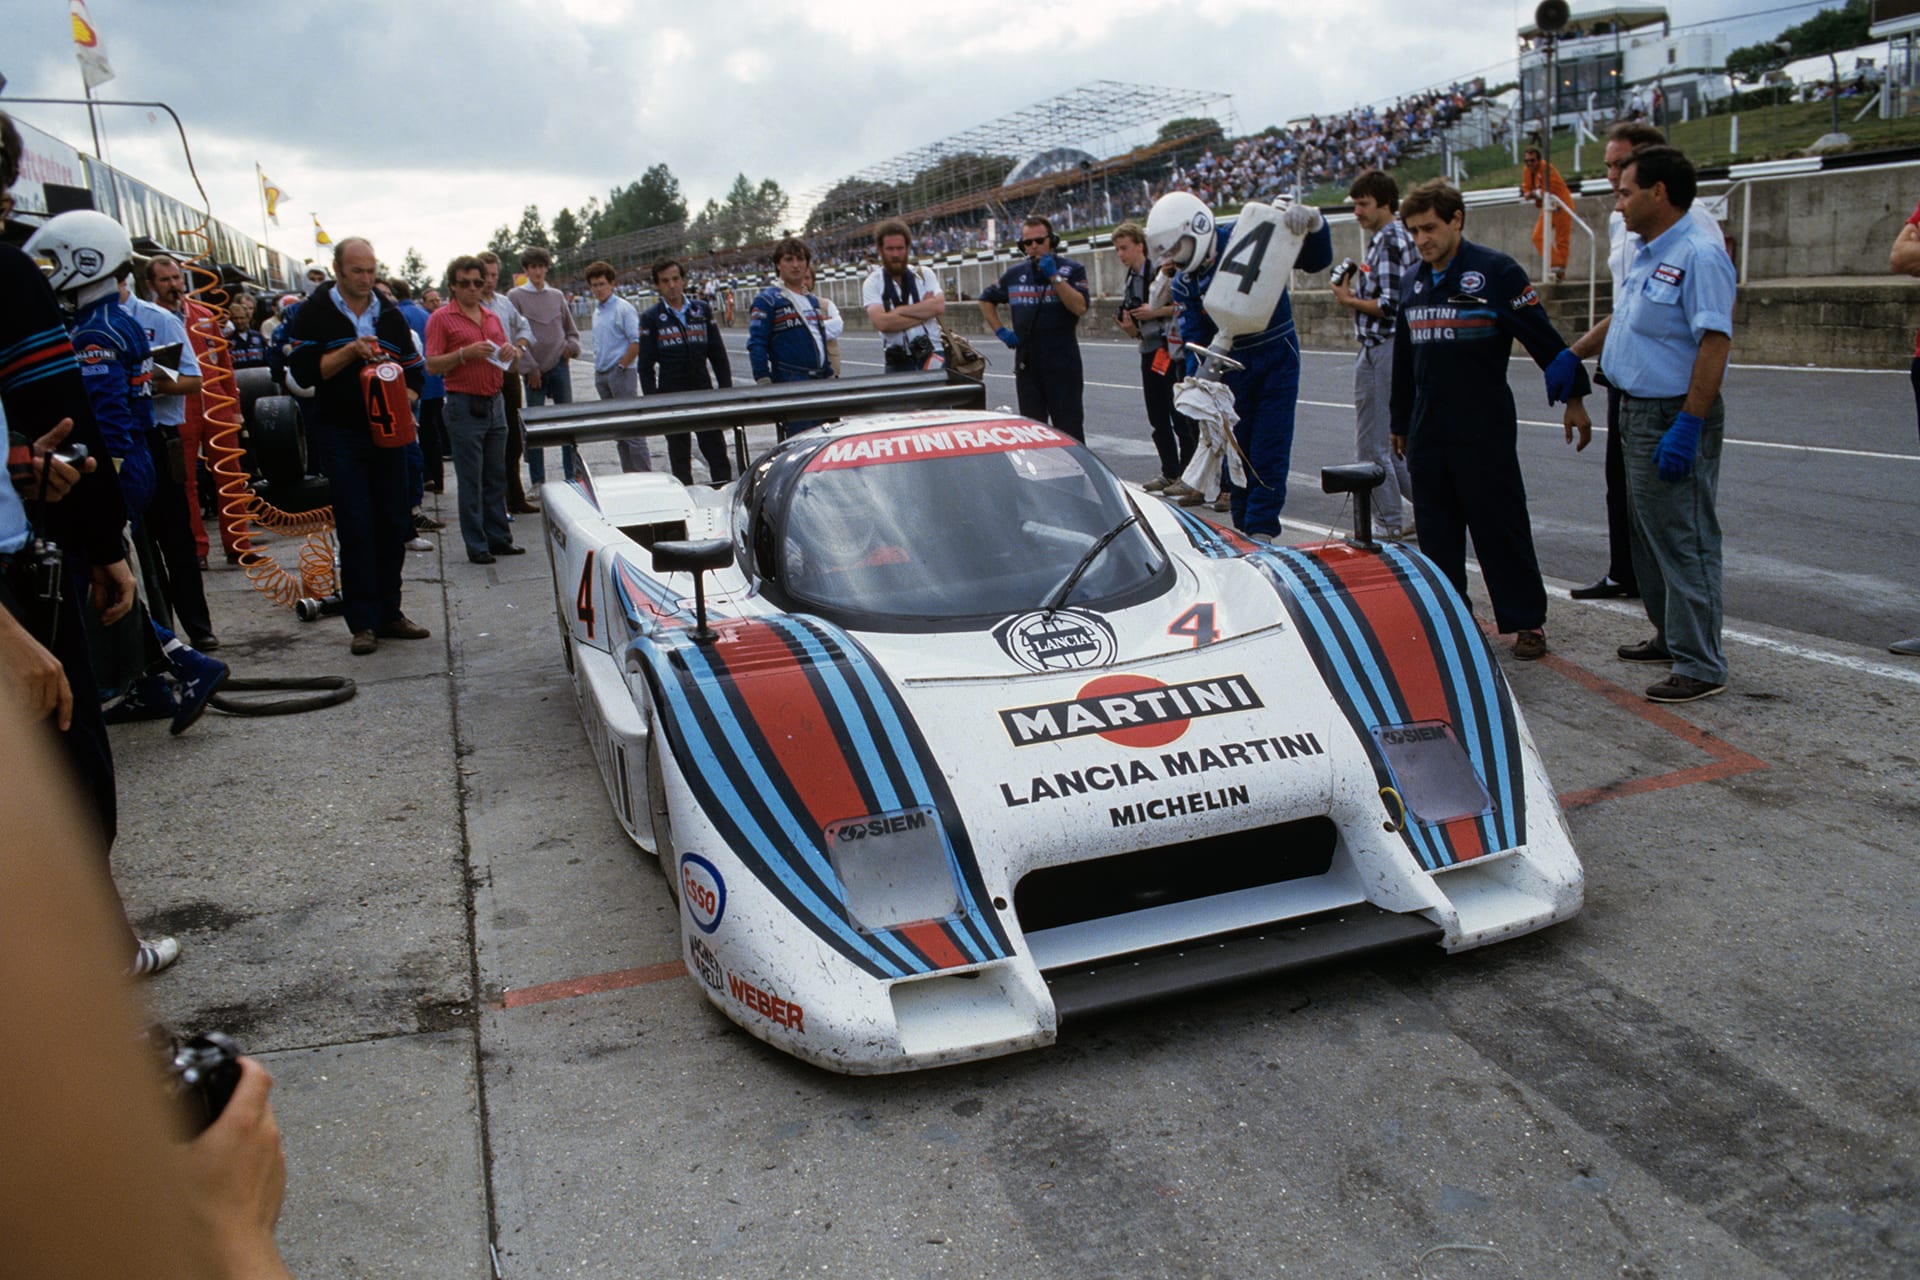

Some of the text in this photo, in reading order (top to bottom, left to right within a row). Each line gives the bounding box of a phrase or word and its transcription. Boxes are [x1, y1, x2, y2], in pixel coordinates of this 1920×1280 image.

[1220, 220, 1276, 295] 4
[367, 374, 397, 437] 4
[821, 422, 1058, 463] MARTINI RACING
[577, 549, 595, 640] 4
[1168, 602, 1221, 648] 4
[1033, 631, 1092, 653] LANCIA
[1010, 679, 1253, 740] MARTINI
[1000, 732, 1325, 807] LANCIA MARTINI
[866, 812, 927, 837] SIEM
[1109, 785, 1250, 828] MICHELIN
[727, 972, 804, 1034] WEBER
